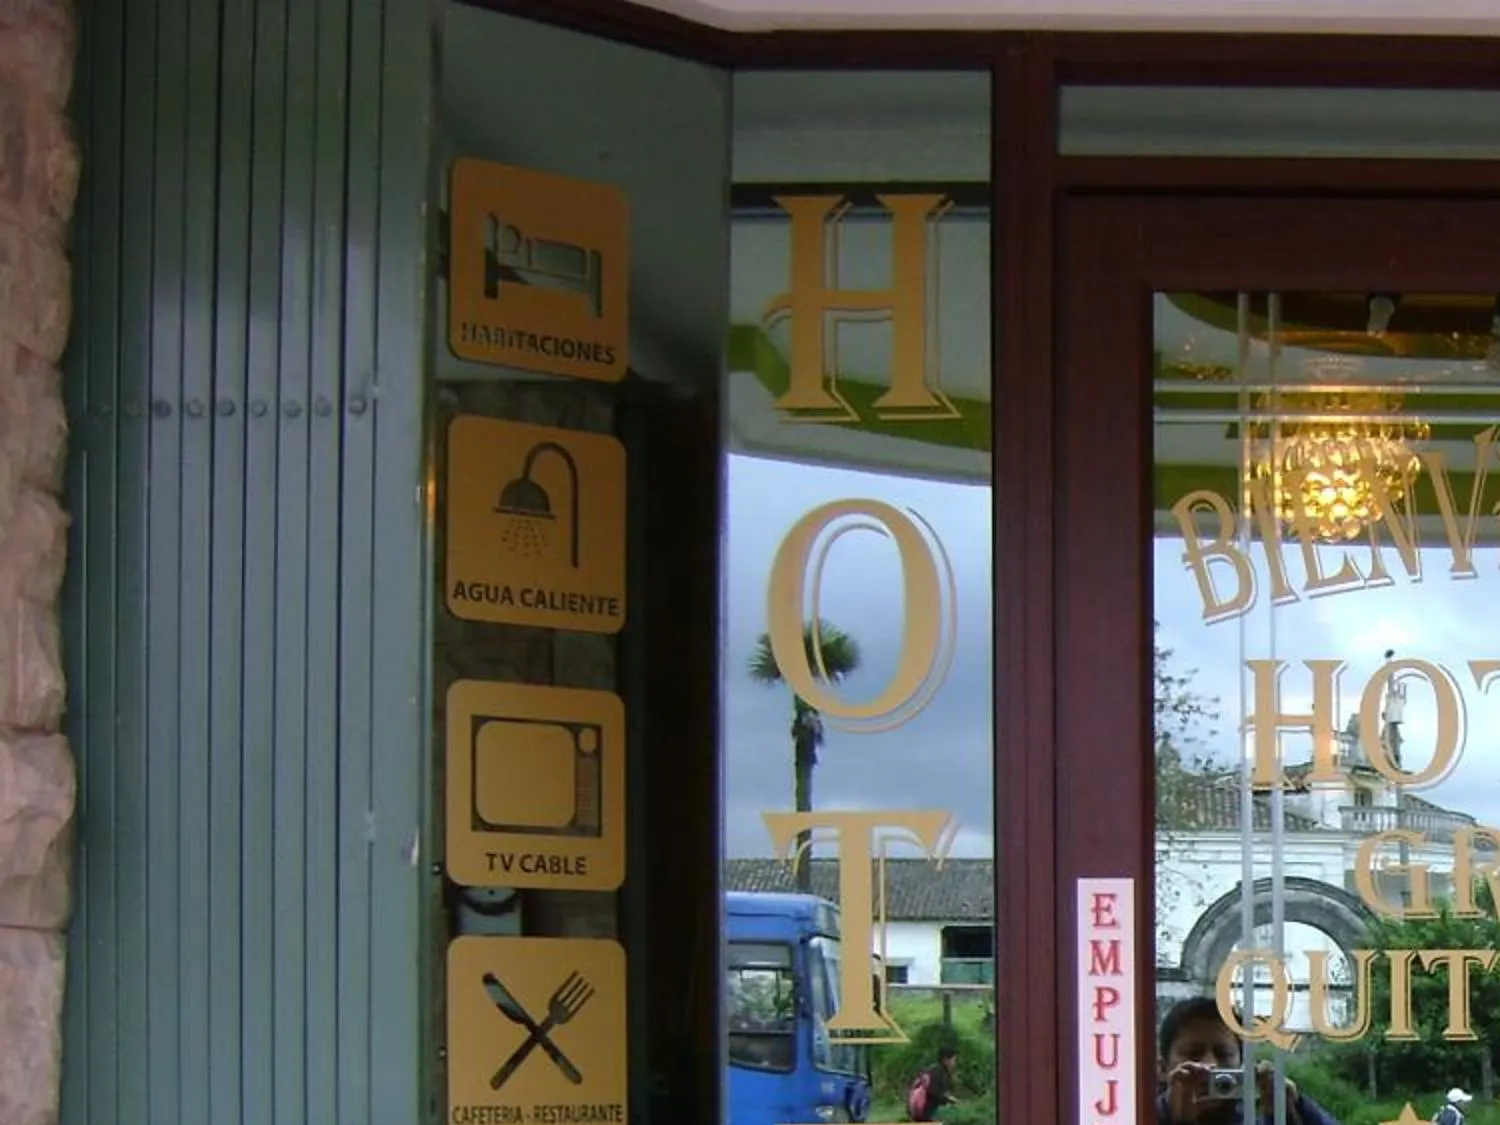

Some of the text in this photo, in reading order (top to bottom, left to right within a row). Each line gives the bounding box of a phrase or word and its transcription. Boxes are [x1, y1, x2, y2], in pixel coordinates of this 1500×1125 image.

[460, 321, 617, 365] HABITACIONES
[452, 581, 620, 617] AGUA CALIENTE
[485, 852, 588, 876] TV CABLE
[533, 1103, 623, 1124] RESTAURANTE
